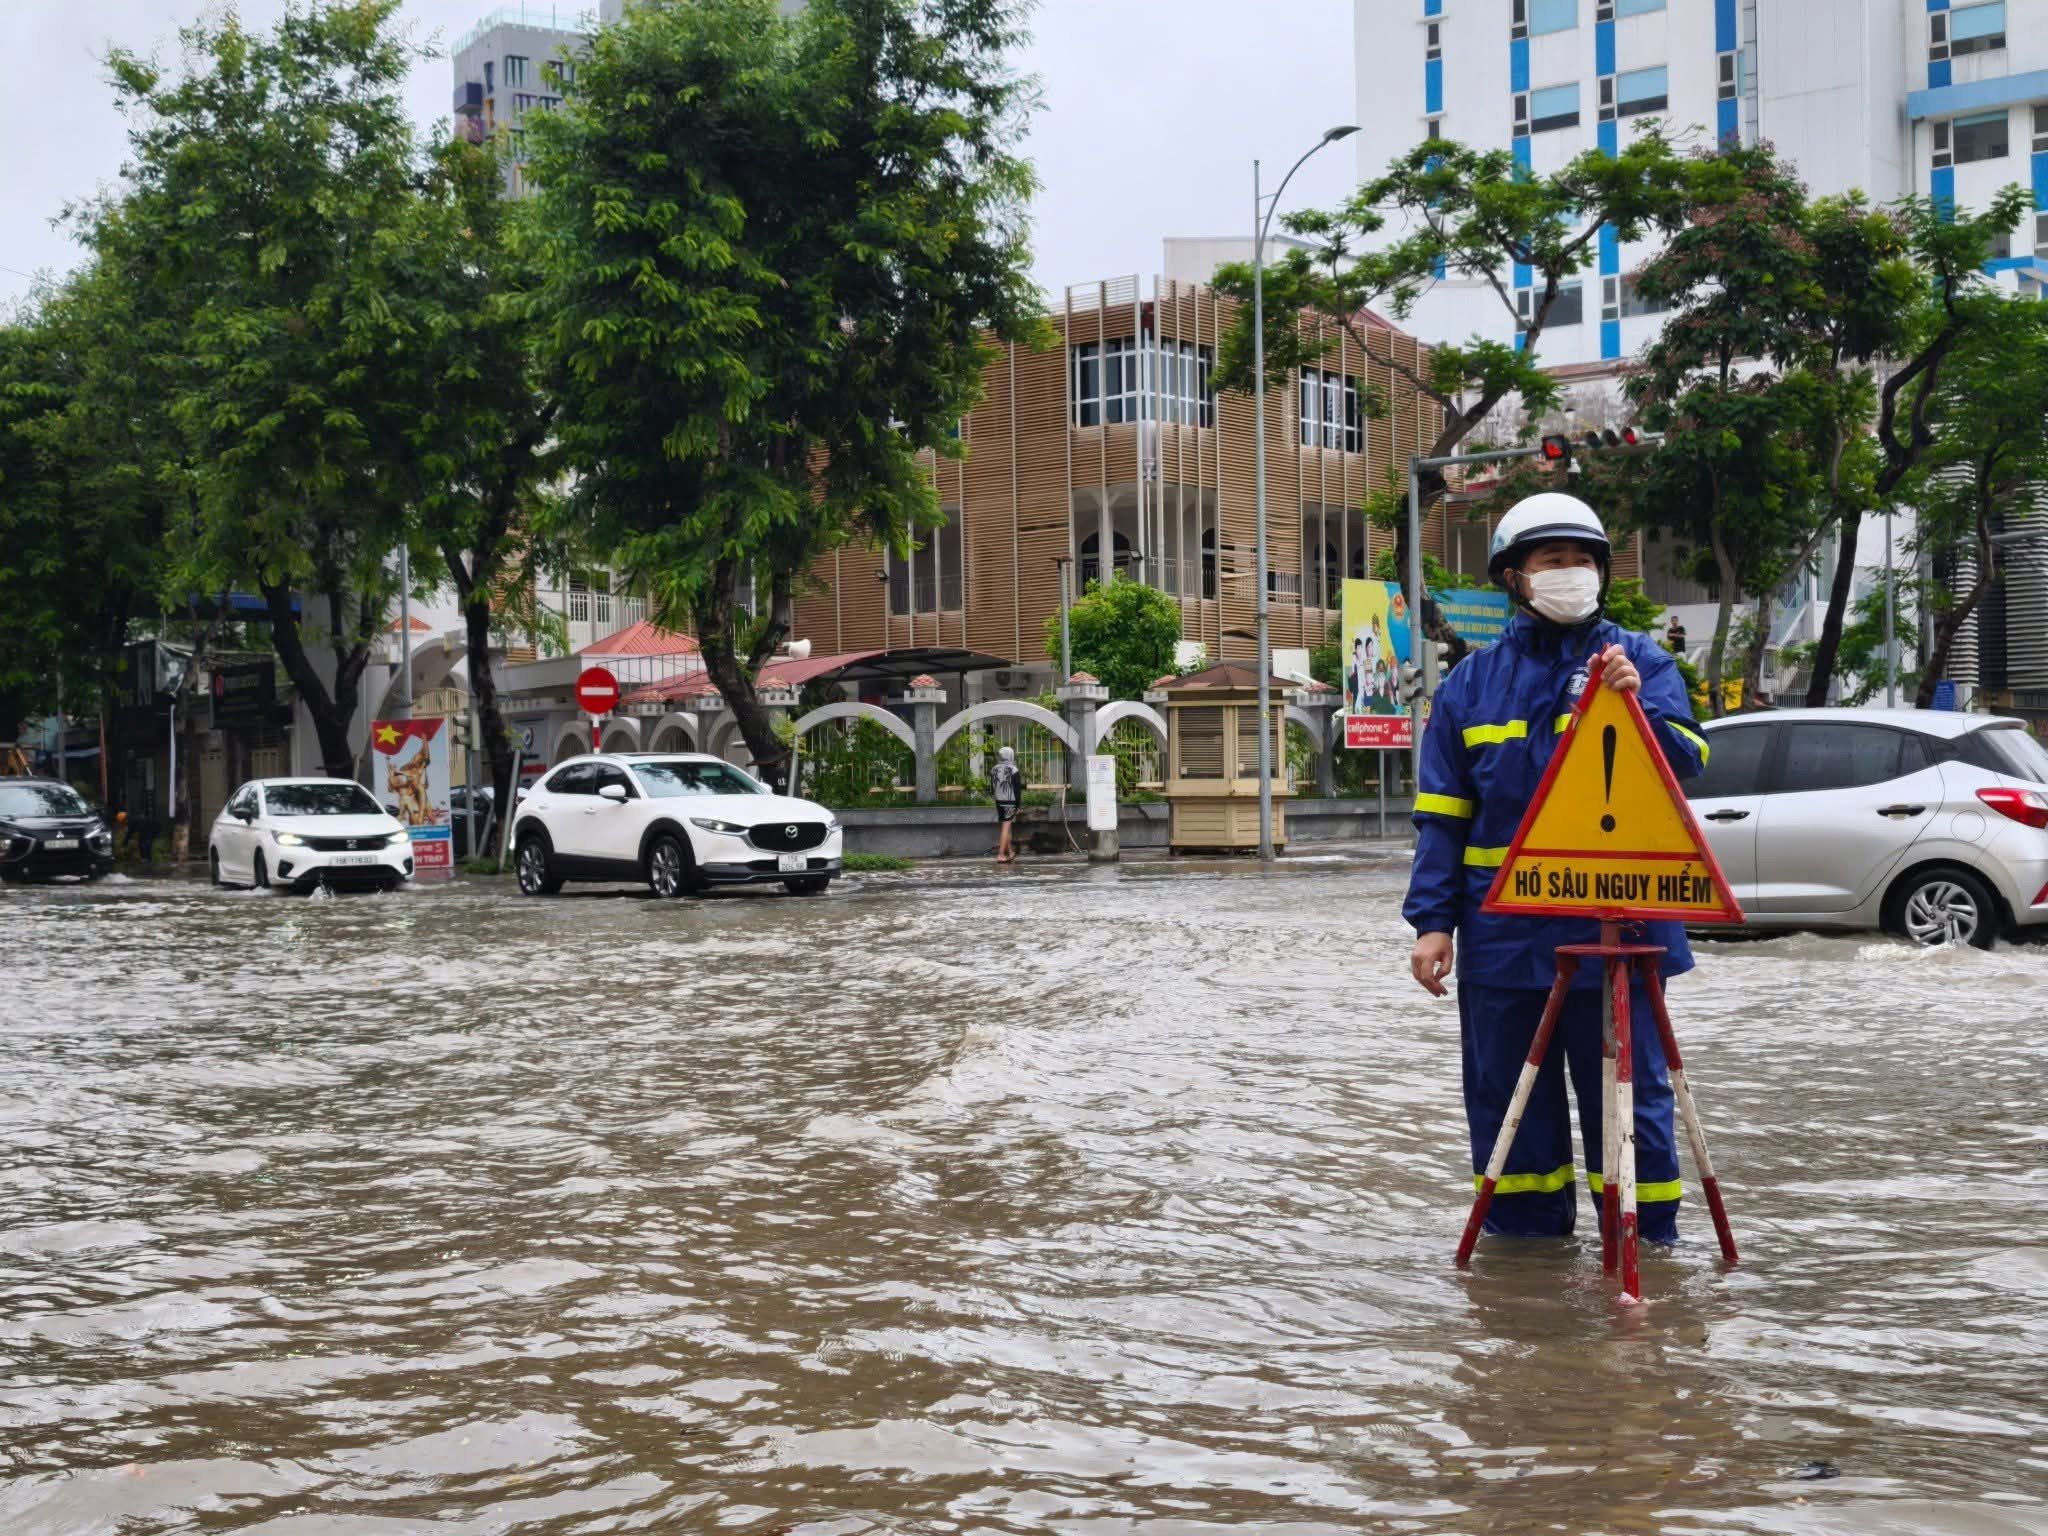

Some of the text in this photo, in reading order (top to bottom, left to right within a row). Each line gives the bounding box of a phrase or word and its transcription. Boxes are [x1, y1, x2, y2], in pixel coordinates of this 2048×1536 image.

[1515, 863, 1711, 903] HỐ SÂU NGUY HIỂM
